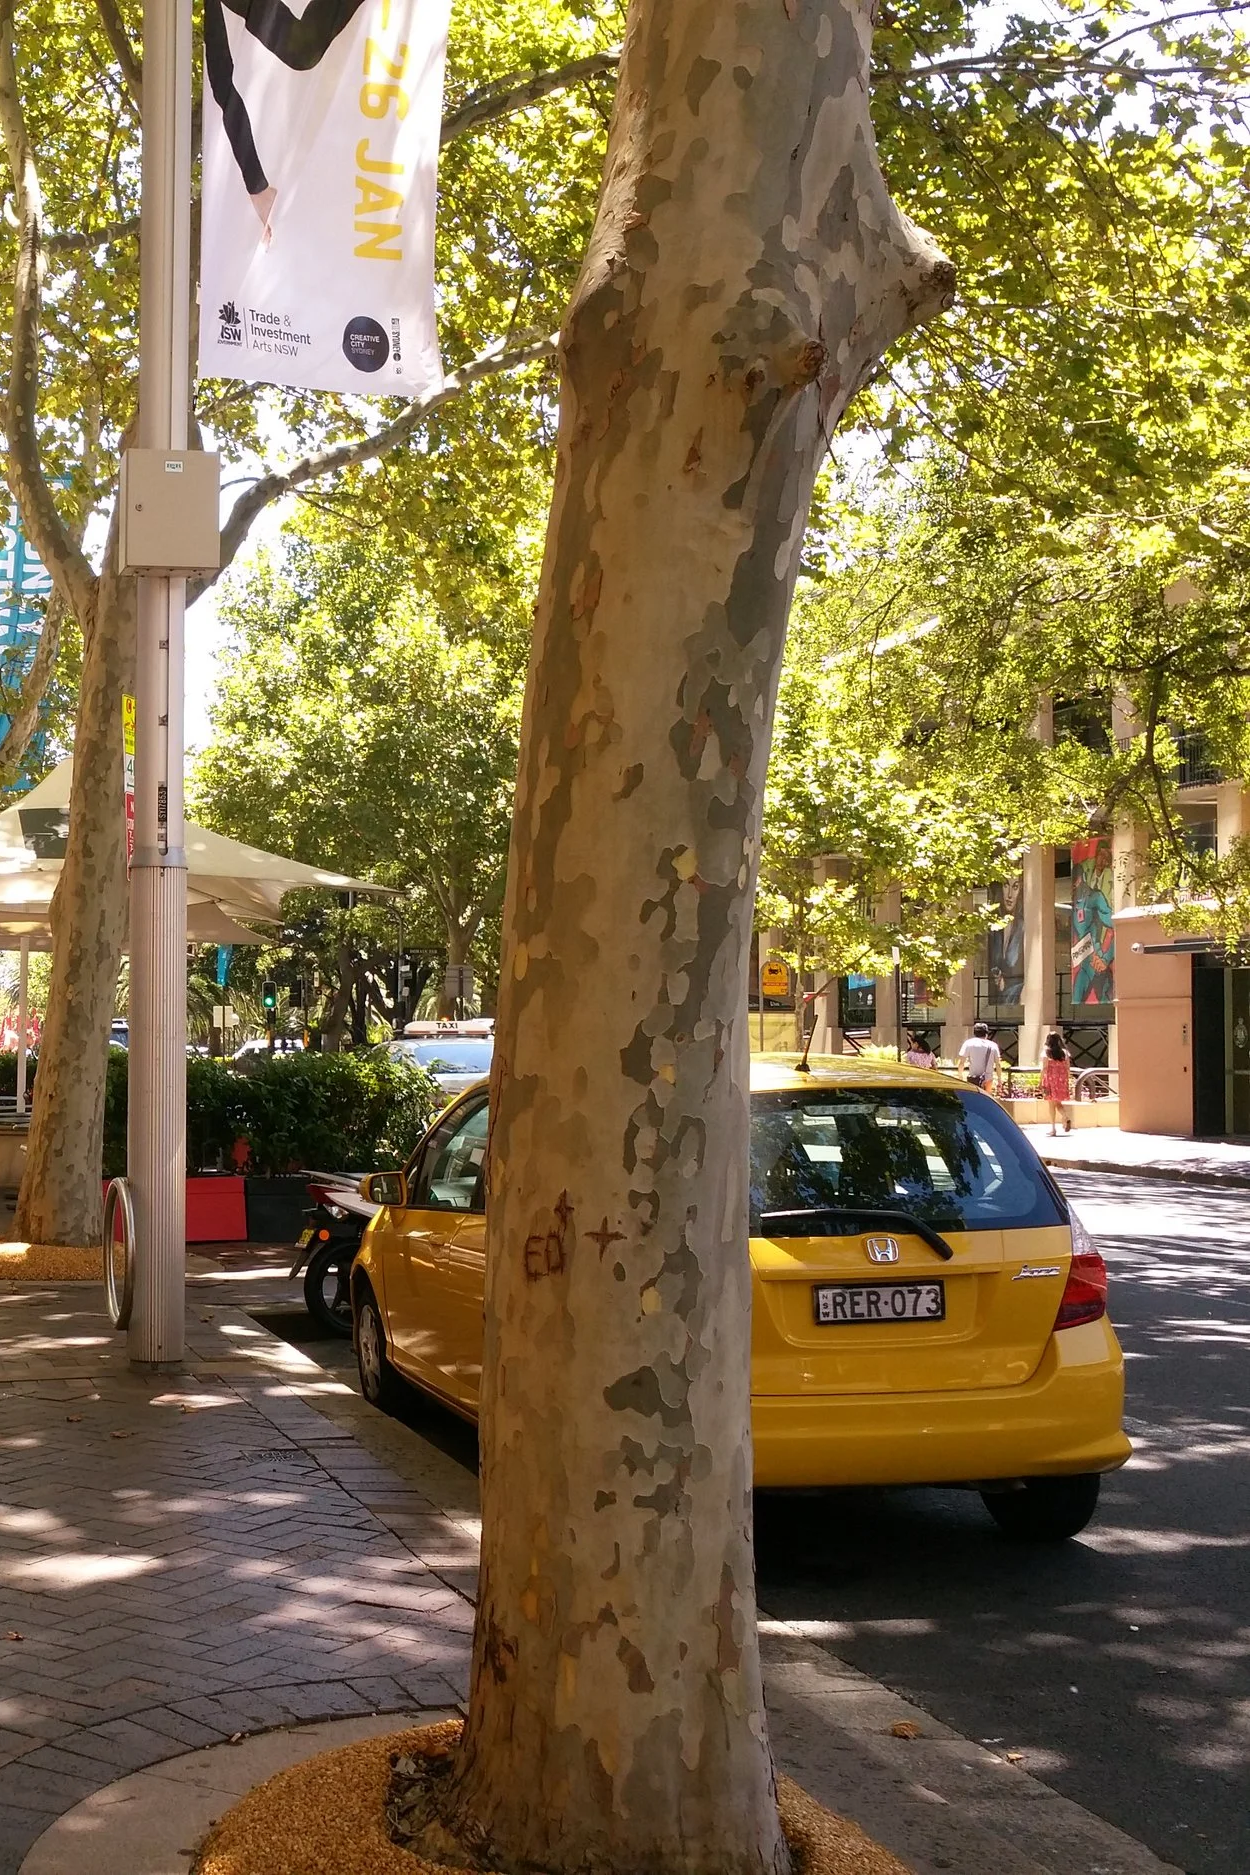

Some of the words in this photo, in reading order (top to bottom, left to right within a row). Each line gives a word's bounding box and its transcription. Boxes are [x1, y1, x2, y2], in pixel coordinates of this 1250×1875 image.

[353, 138, 405, 262] JAN
[249, 308, 280, 326] Trade
[283, 314, 292, 328] &
[250, 323, 311, 346] Investment
[350, 333, 380, 343] CREATIVE
[252, 339, 272, 353] Arts
[274, 343, 299, 357] NSW
[351, 347, 375, 356] SYDNEY
